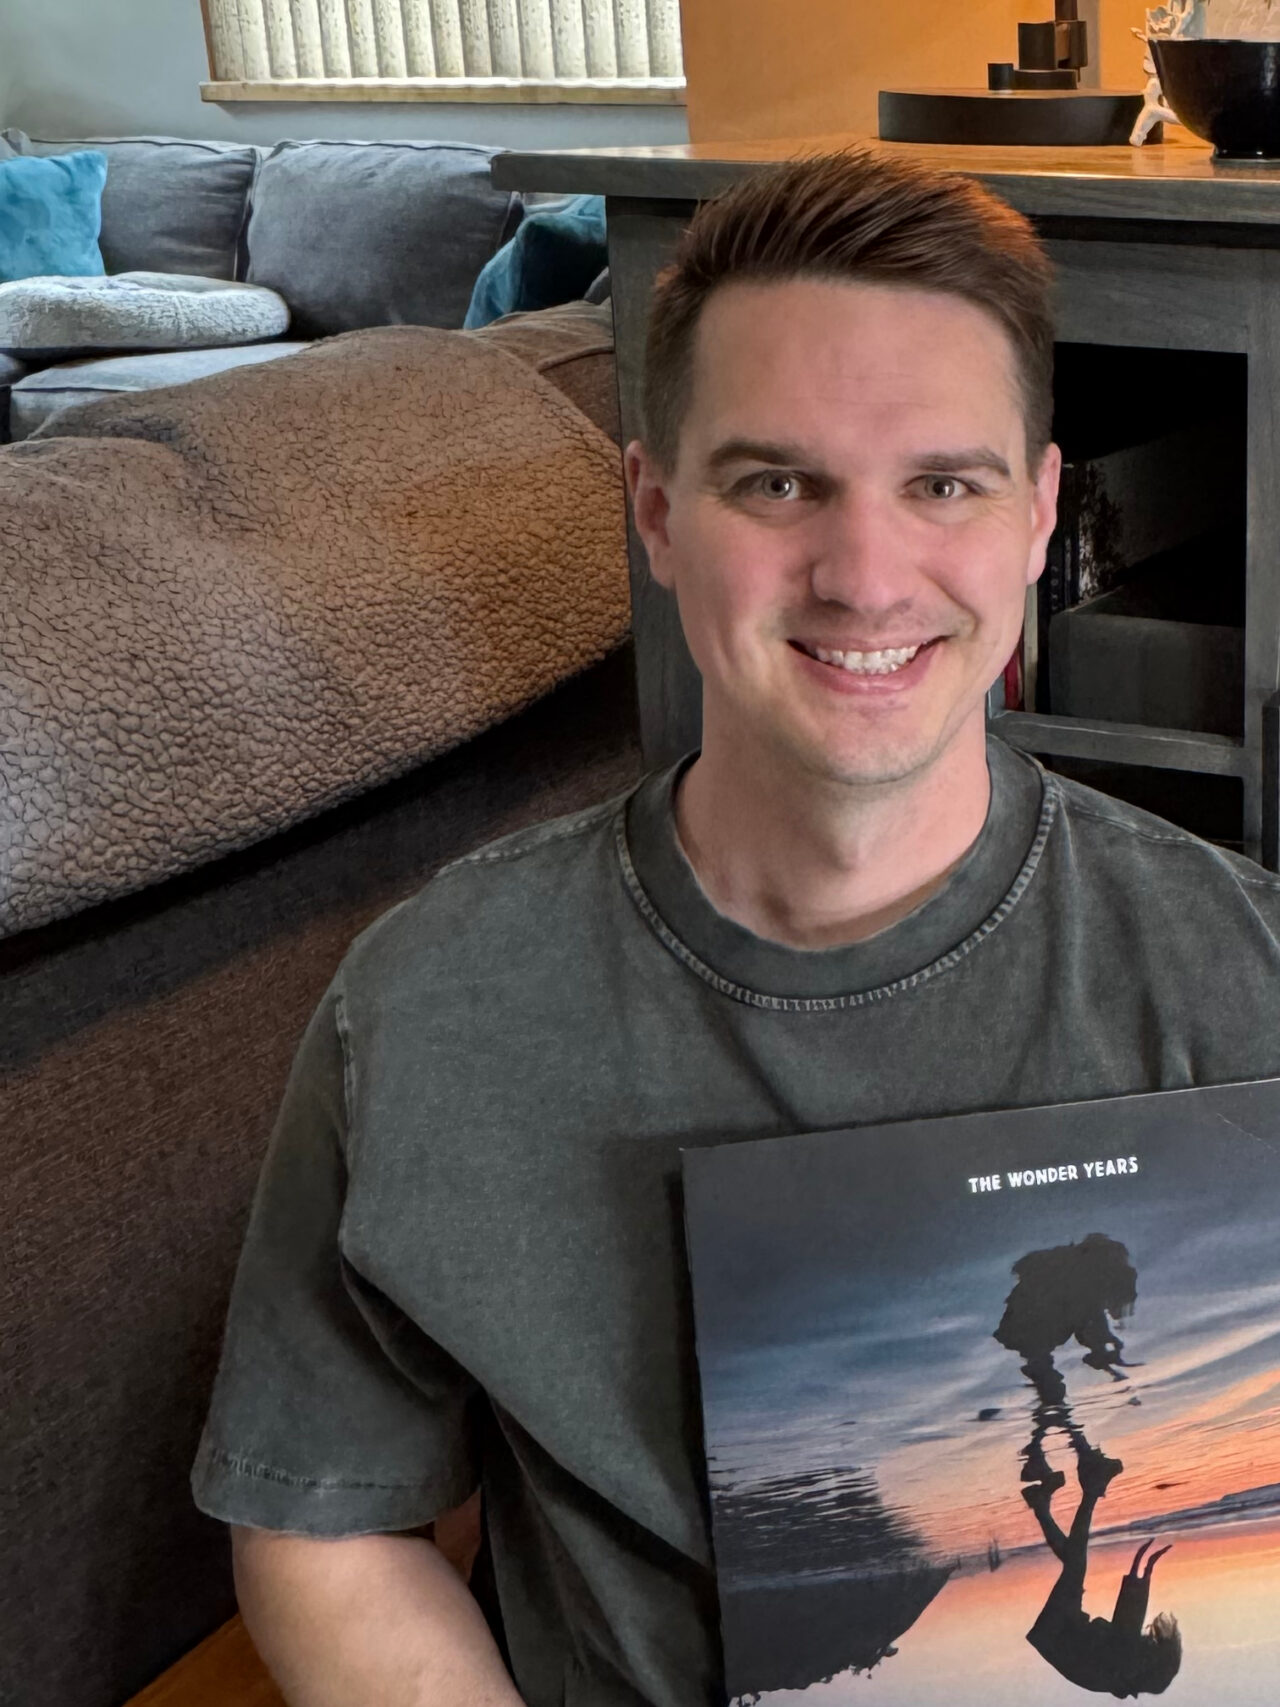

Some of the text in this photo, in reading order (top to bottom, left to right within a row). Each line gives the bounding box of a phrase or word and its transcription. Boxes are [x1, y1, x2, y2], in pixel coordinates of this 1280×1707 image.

[968, 1156, 1139, 1193] THE WONDER YEARS
